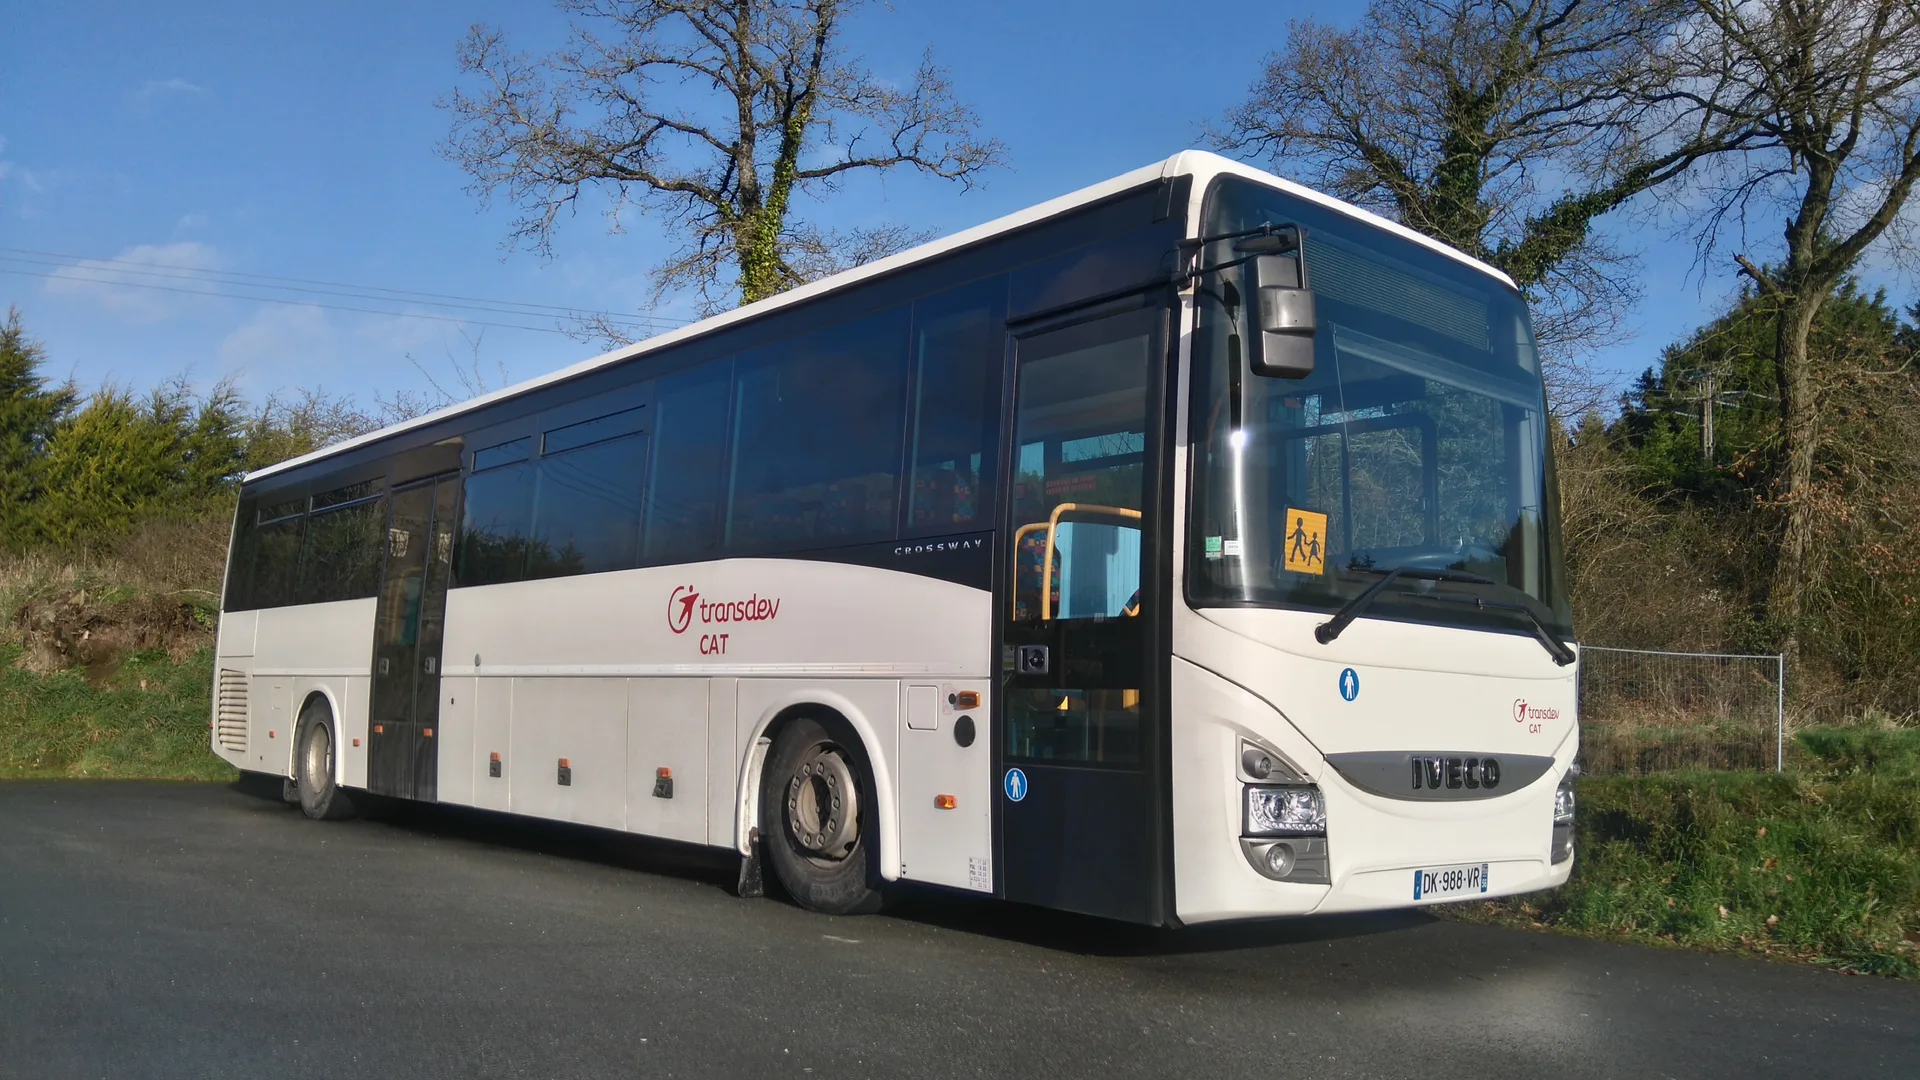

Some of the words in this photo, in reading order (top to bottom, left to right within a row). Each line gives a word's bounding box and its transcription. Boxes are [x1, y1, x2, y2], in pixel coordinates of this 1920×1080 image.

[894, 538, 983, 556] CROSSWAY
[700, 593, 780, 623] transdev
[699, 633, 729, 655] CAT
[1528, 707, 1560, 720] transdev
[1528, 724, 1541, 734] CAT
[1411, 756, 1500, 790] IVECO
[1423, 867, 1480, 894] DK-988-VR
